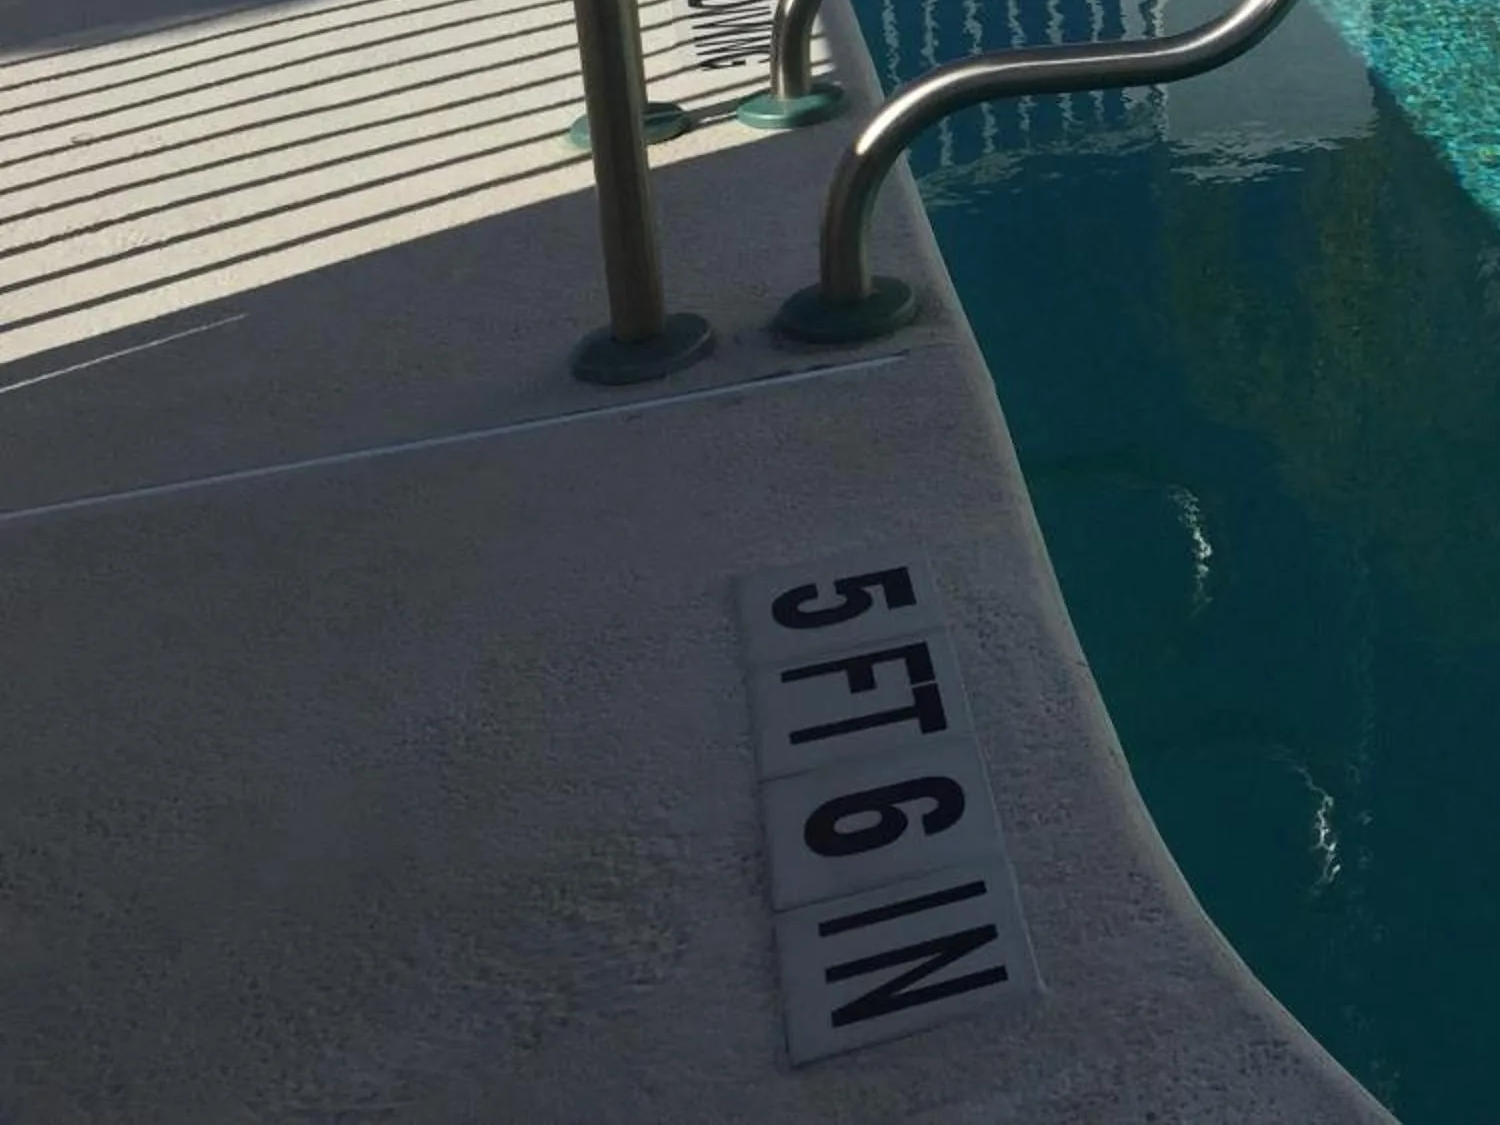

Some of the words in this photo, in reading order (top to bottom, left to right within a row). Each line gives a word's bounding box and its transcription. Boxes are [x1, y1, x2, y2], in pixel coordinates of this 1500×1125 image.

[772, 566, 917, 629] 5
[780, 642, 947, 745] FT
[804, 776, 967, 858] 6
[818, 880, 1009, 1028] IN
